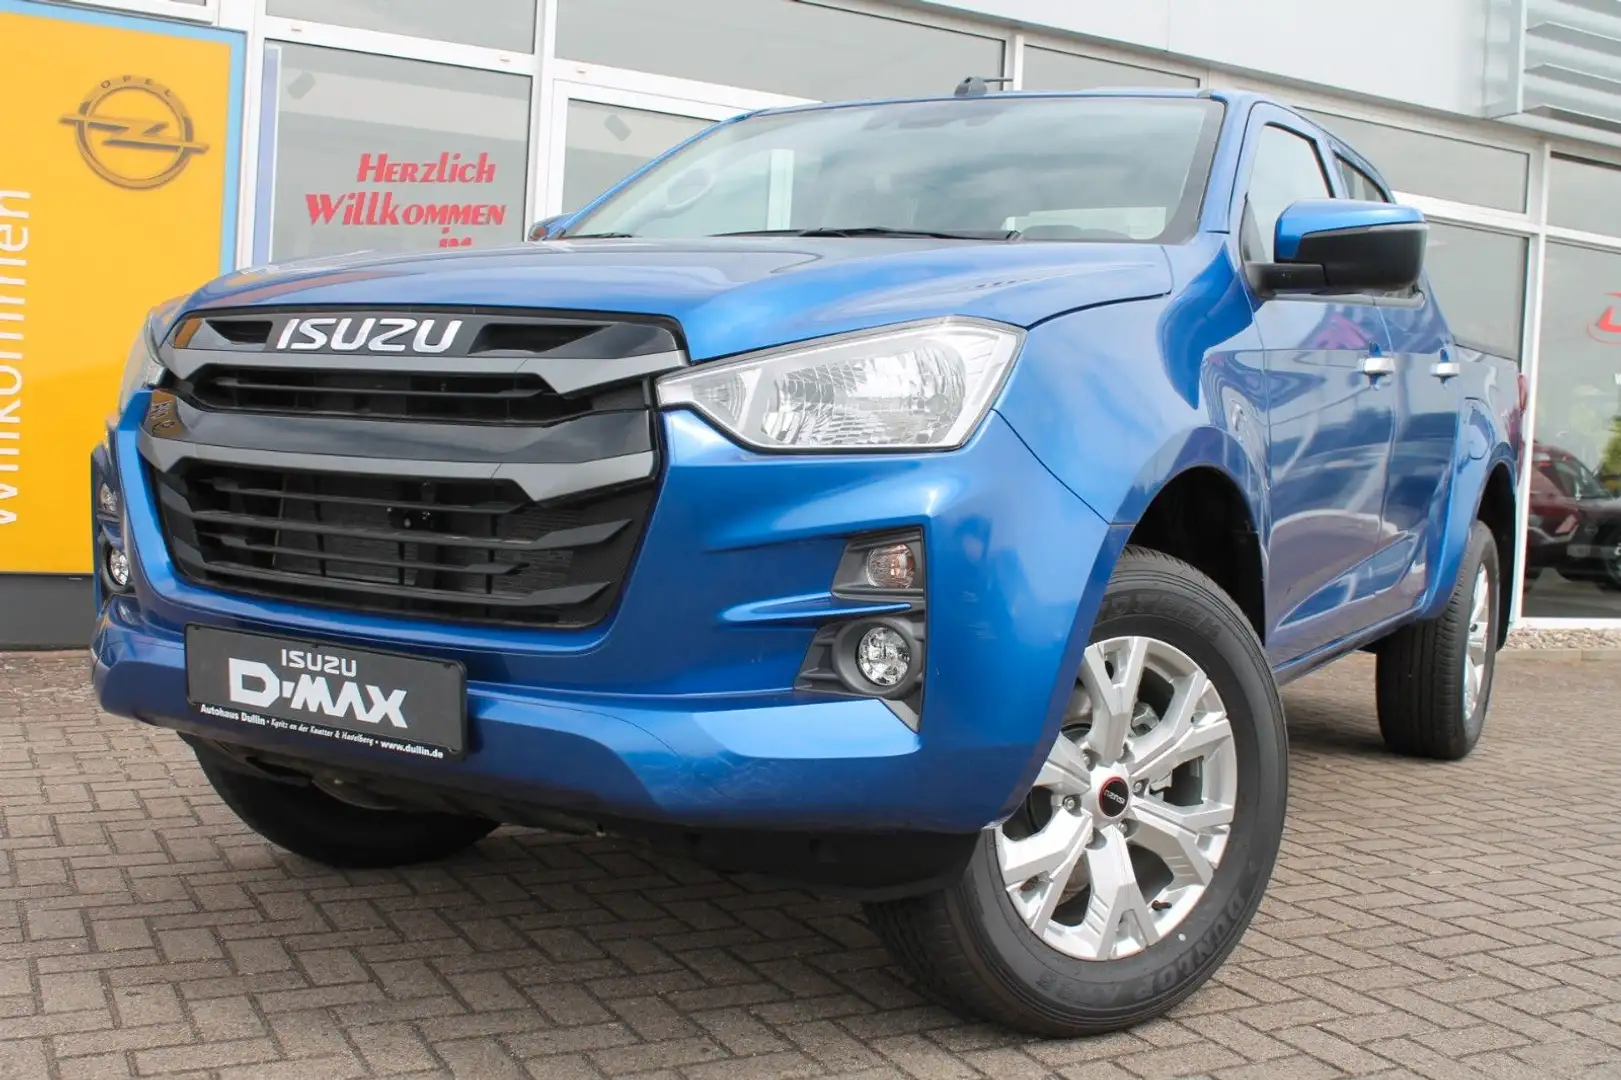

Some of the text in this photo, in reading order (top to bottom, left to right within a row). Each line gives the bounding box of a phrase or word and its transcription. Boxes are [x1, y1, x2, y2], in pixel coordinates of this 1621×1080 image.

[101, 75, 171, 98] OPEL
[276, 318, 463, 353] ISUZU
[281, 649, 357, 678] ISUZU
[228, 657, 408, 728] D-MAX
[200, 704, 239, 720] Autohaus
[241, 712, 266, 726] Dullin
[380, 740, 444, 759] www.dullin.de
[1136, 888, 1248, 999] DUNLOP
